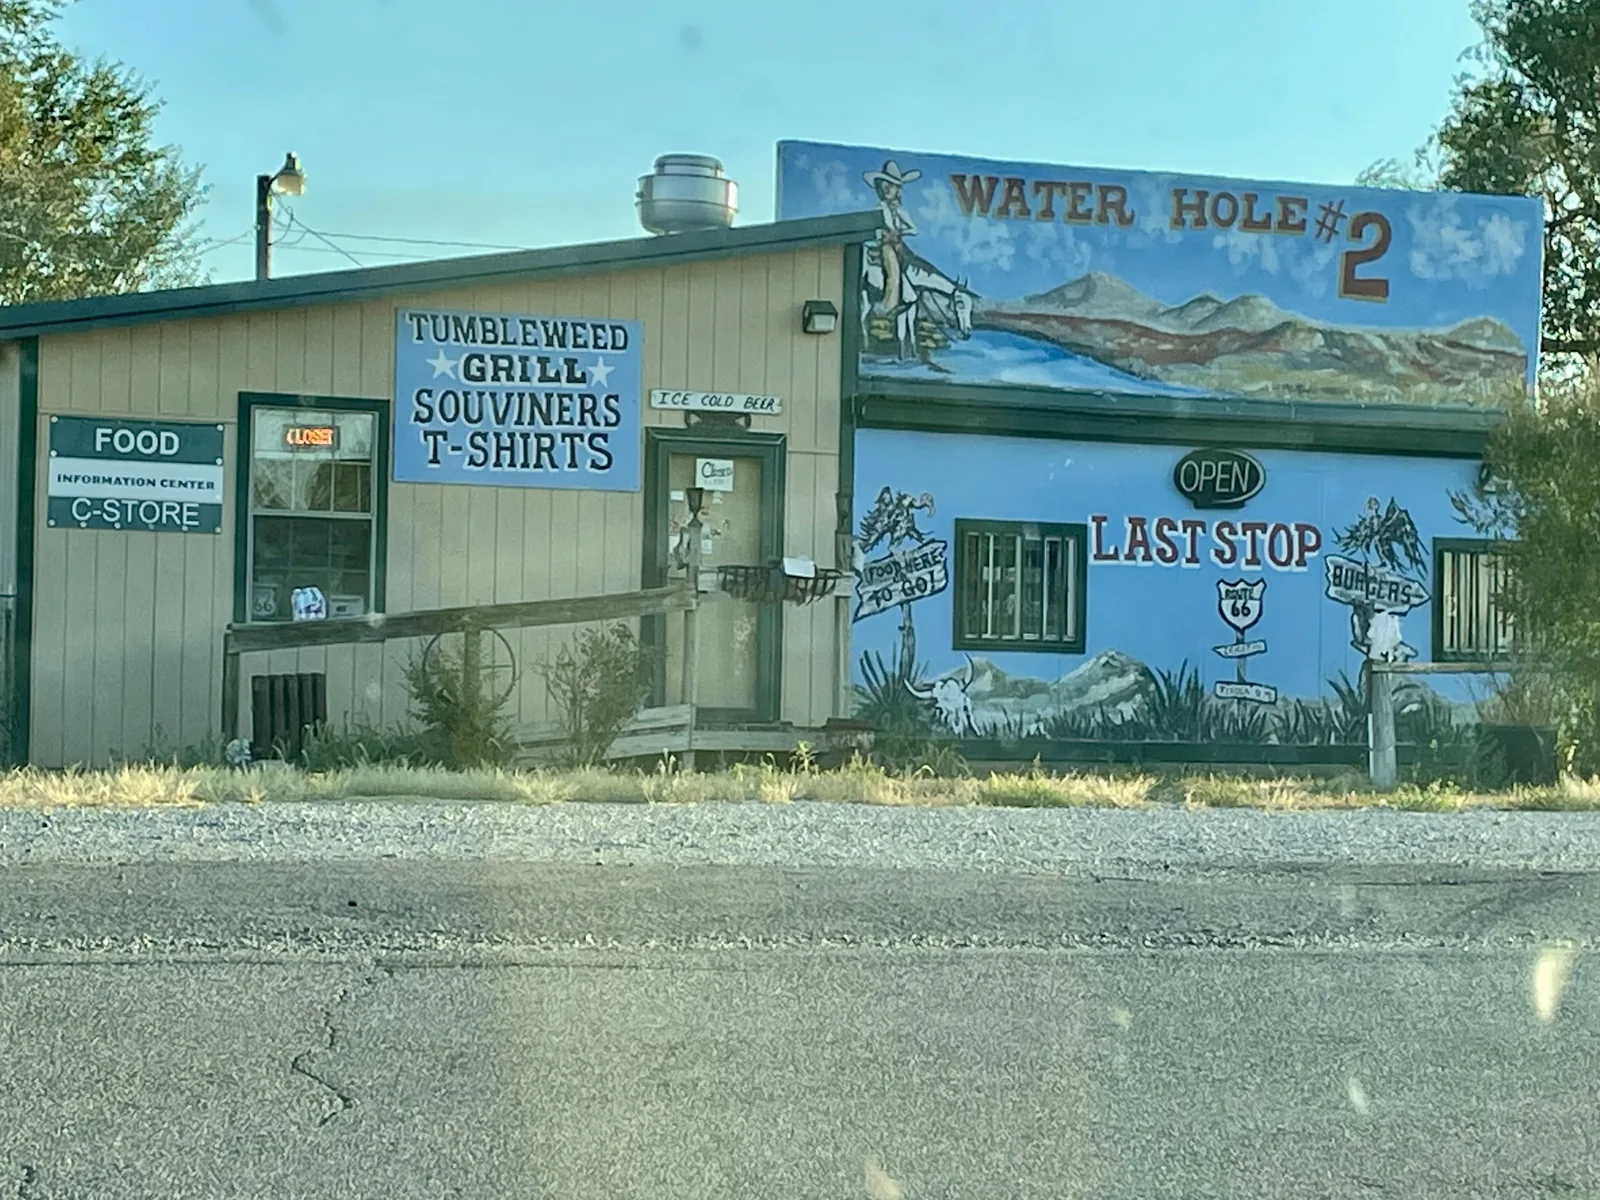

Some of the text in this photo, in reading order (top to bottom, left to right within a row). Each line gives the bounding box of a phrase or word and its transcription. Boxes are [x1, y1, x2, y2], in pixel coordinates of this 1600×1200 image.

[950, 174, 1135, 228] WATER
[1170, 187, 1308, 234] HOLE
[407, 313, 629, 351] TUMBLEWEED
[461, 352, 588, 386] GRILL
[412, 388, 622, 428] SOUVINERS
[658, 392, 776, 412] ICE COLD BEER
[95, 428, 180, 455] FOOD
[422, 430, 614, 471] T-SHIRTS
[57, 473, 215, 489] INFORMATION CENTER
[1179, 460, 1250, 493] OPEN
[72, 497, 199, 526] C-STORE
[1088, 515, 1322, 572] LAST STOP
[867, 570, 936, 608] TO GO!
[1332, 565, 1413, 605] BURGERS
[1231, 600, 1251, 617] 66
